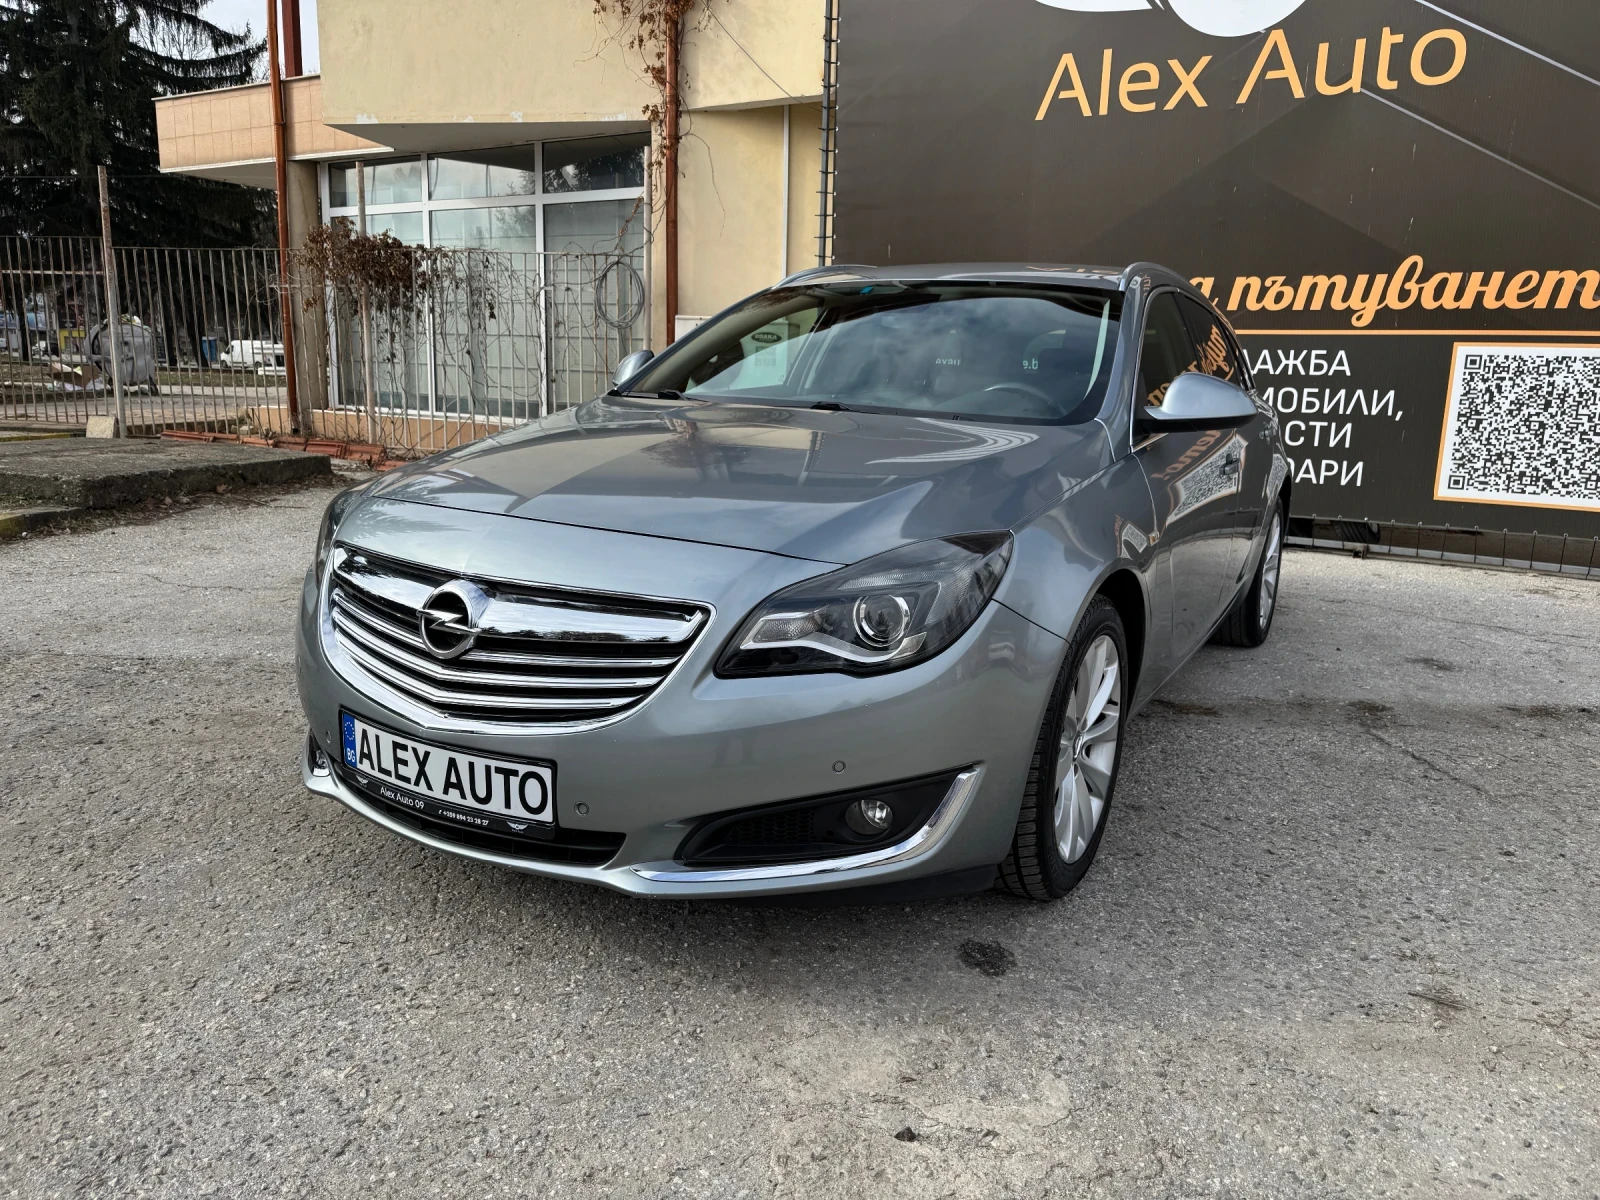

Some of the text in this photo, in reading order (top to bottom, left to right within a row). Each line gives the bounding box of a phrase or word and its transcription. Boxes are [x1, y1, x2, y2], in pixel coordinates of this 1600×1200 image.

[1036, 27, 1467, 121] Alex Auto
[1284, 420, 1353, 449] СТИ
[346, 747, 356, 763] BG
[358, 728, 548, 816] ALEX AUTO
[380, 786, 395, 800] Alex
[396, 792, 413, 806] Auto
[414, 799, 425, 810] 09
